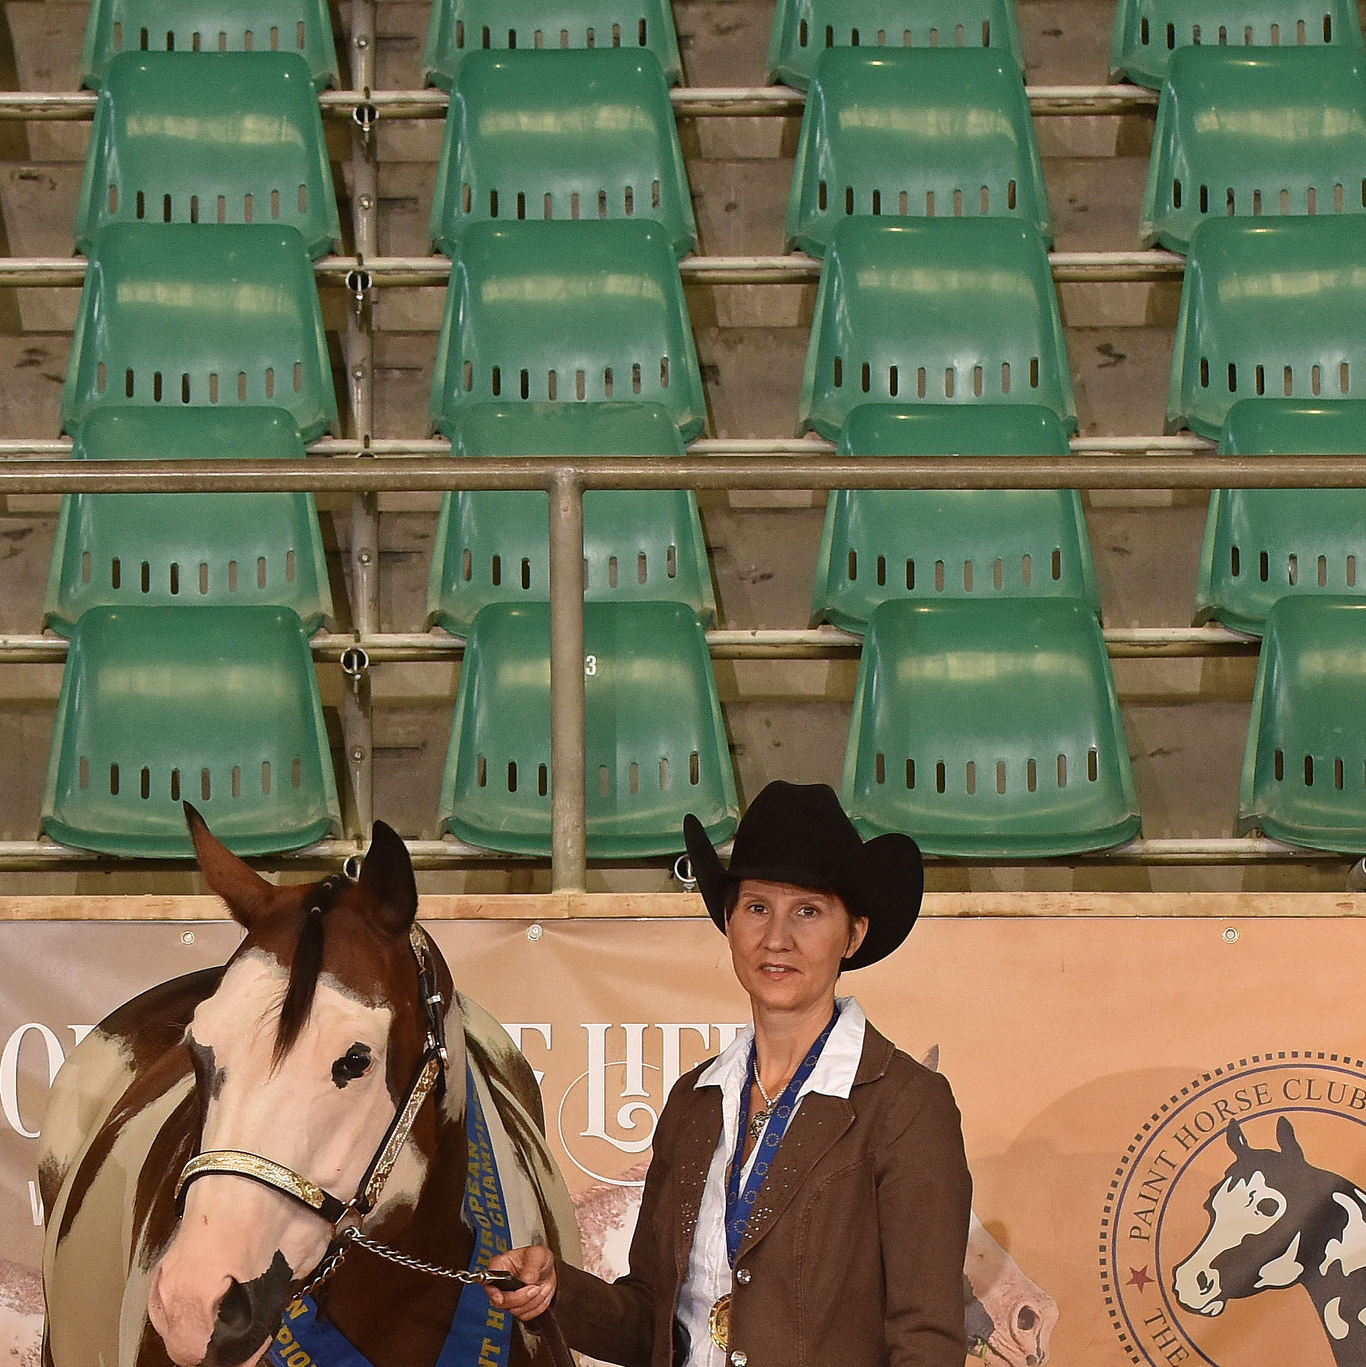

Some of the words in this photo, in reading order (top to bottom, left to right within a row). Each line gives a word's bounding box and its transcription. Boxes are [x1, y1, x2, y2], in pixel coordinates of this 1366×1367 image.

[468, 1140, 493, 1272] UROPEAN
[1129, 1150, 1176, 1243] PAINT
[1172, 1082, 1274, 1152] HORSE
